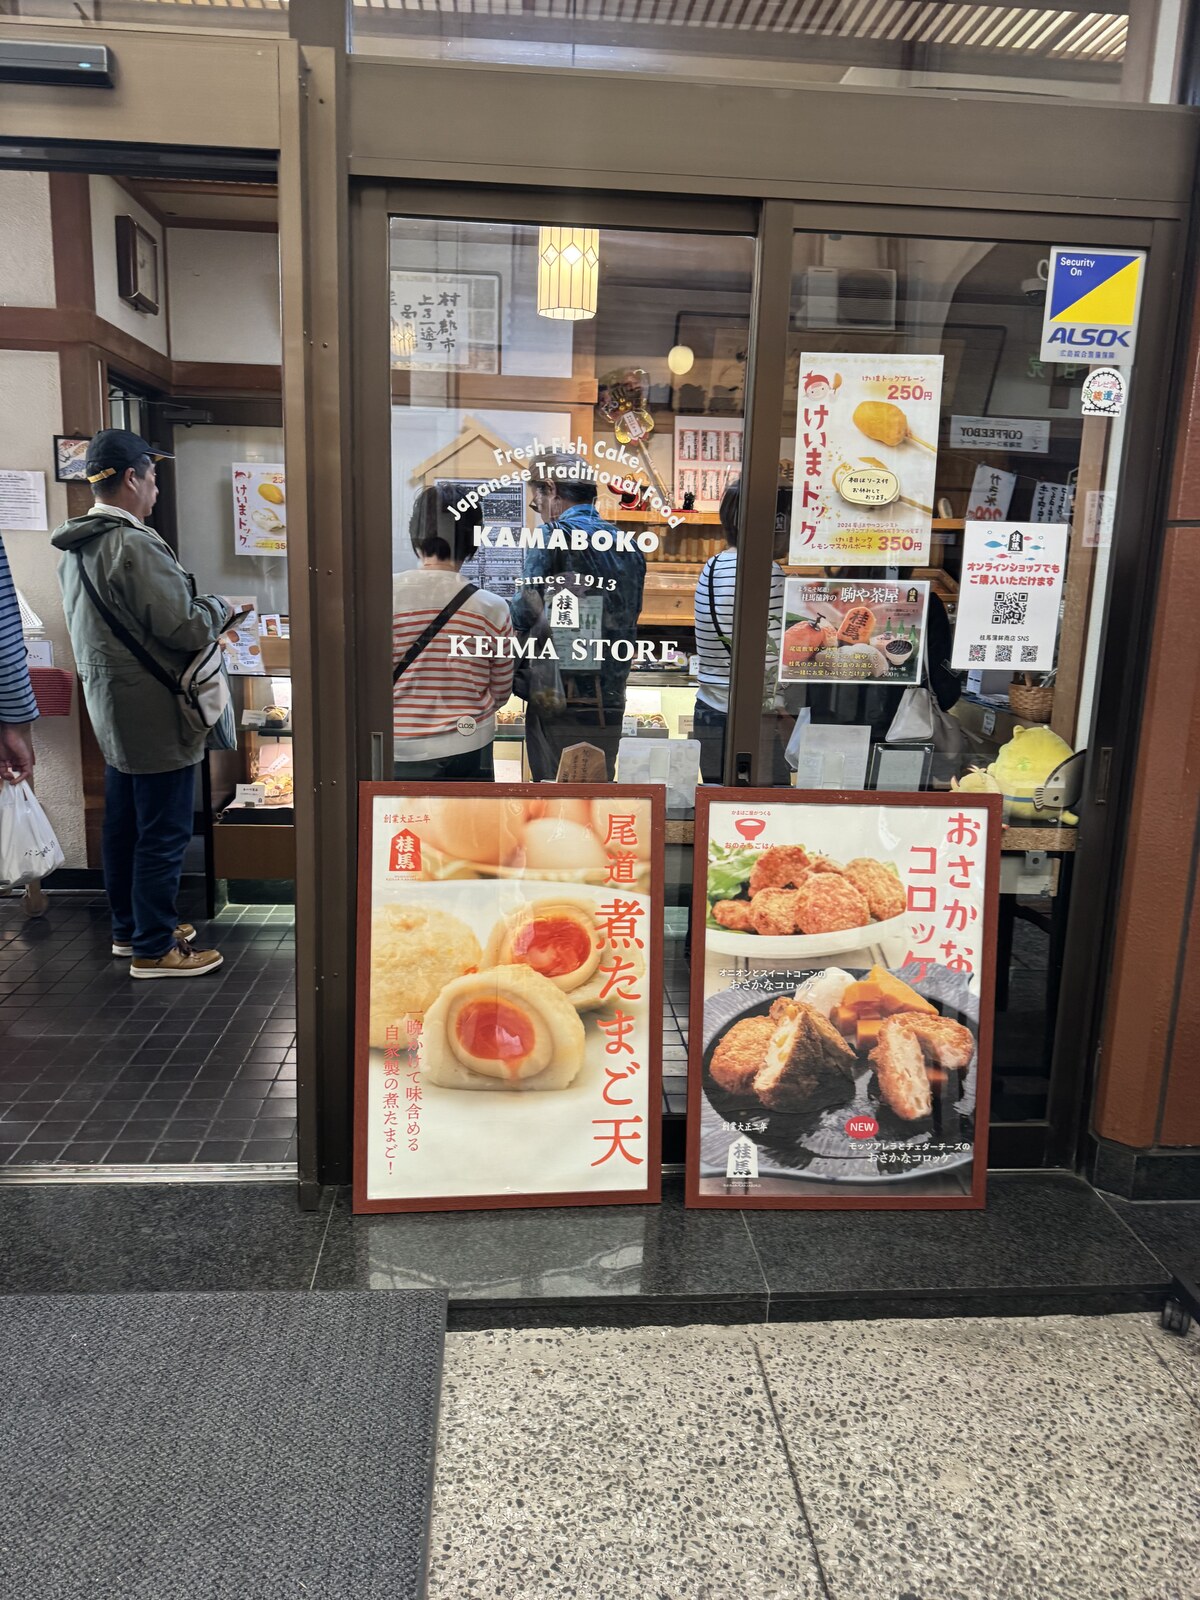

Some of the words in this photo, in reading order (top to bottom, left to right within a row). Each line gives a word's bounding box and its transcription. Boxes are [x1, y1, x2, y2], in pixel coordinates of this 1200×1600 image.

[1060, 257, 1095, 269] Security
[1070, 267, 1083, 276] On
[1047, 327, 1132, 348] ALSOK
[887, 384, 933, 401] 250円
[493, 442, 546, 467] Fresh
[551, 437, 588, 456] Fish
[593, 441, 642, 473] Cake,
[799, 404, 830, 546] けいまドッグ
[446, 469, 533, 521] Japanese
[535, 462, 642, 497] Traditional
[642, 484, 686, 529] Food
[473, 525, 659, 553] KAMABOKO
[878, 536, 923, 551] 350円
[1010, 533, 1021, 551] 桂馬
[967, 562, 1060, 574] オンラインショップでも
[514, 573, 566, 588] since
[573, 573, 617, 592] 1913
[969, 574, 1056, 586] ご購入いただけます
[840, 587, 899, 604] 駒や茶屋
[556, 595, 574, 626] 桂馬
[842, 610, 870, 641] 桂馬
[979, 634, 1016, 642] 桂馬蒲鉾商店
[448, 635, 560, 660] KEIMA
[571, 639, 679, 662] STORE
[384, 814, 431, 824] 創業大正二年
[395, 835, 415, 869] 桂馬
[603, 812, 639, 884] 尾道
[725, 842, 775, 850] おのみちごはん
[939, 812, 981, 974] おさかな
[901, 845, 937, 983] コロッケ
[719, 968, 826, 978] オニオンとスイートコーンの
[730, 978, 815, 991] おさかなコロッケ
[590, 898, 647, 1167] 煮たまご天
[404, 1010, 424, 1152] 一晩かけて味含める
[382, 1024, 400, 1175] 自家製の煮たまご！
[721, 1121, 768, 1132] 創業大正二年
[850, 1122, 875, 1132] NEW
[733, 1143, 752, 1176] 桂馬
[867, 1152, 951, 1164] おさかなコロッケ
